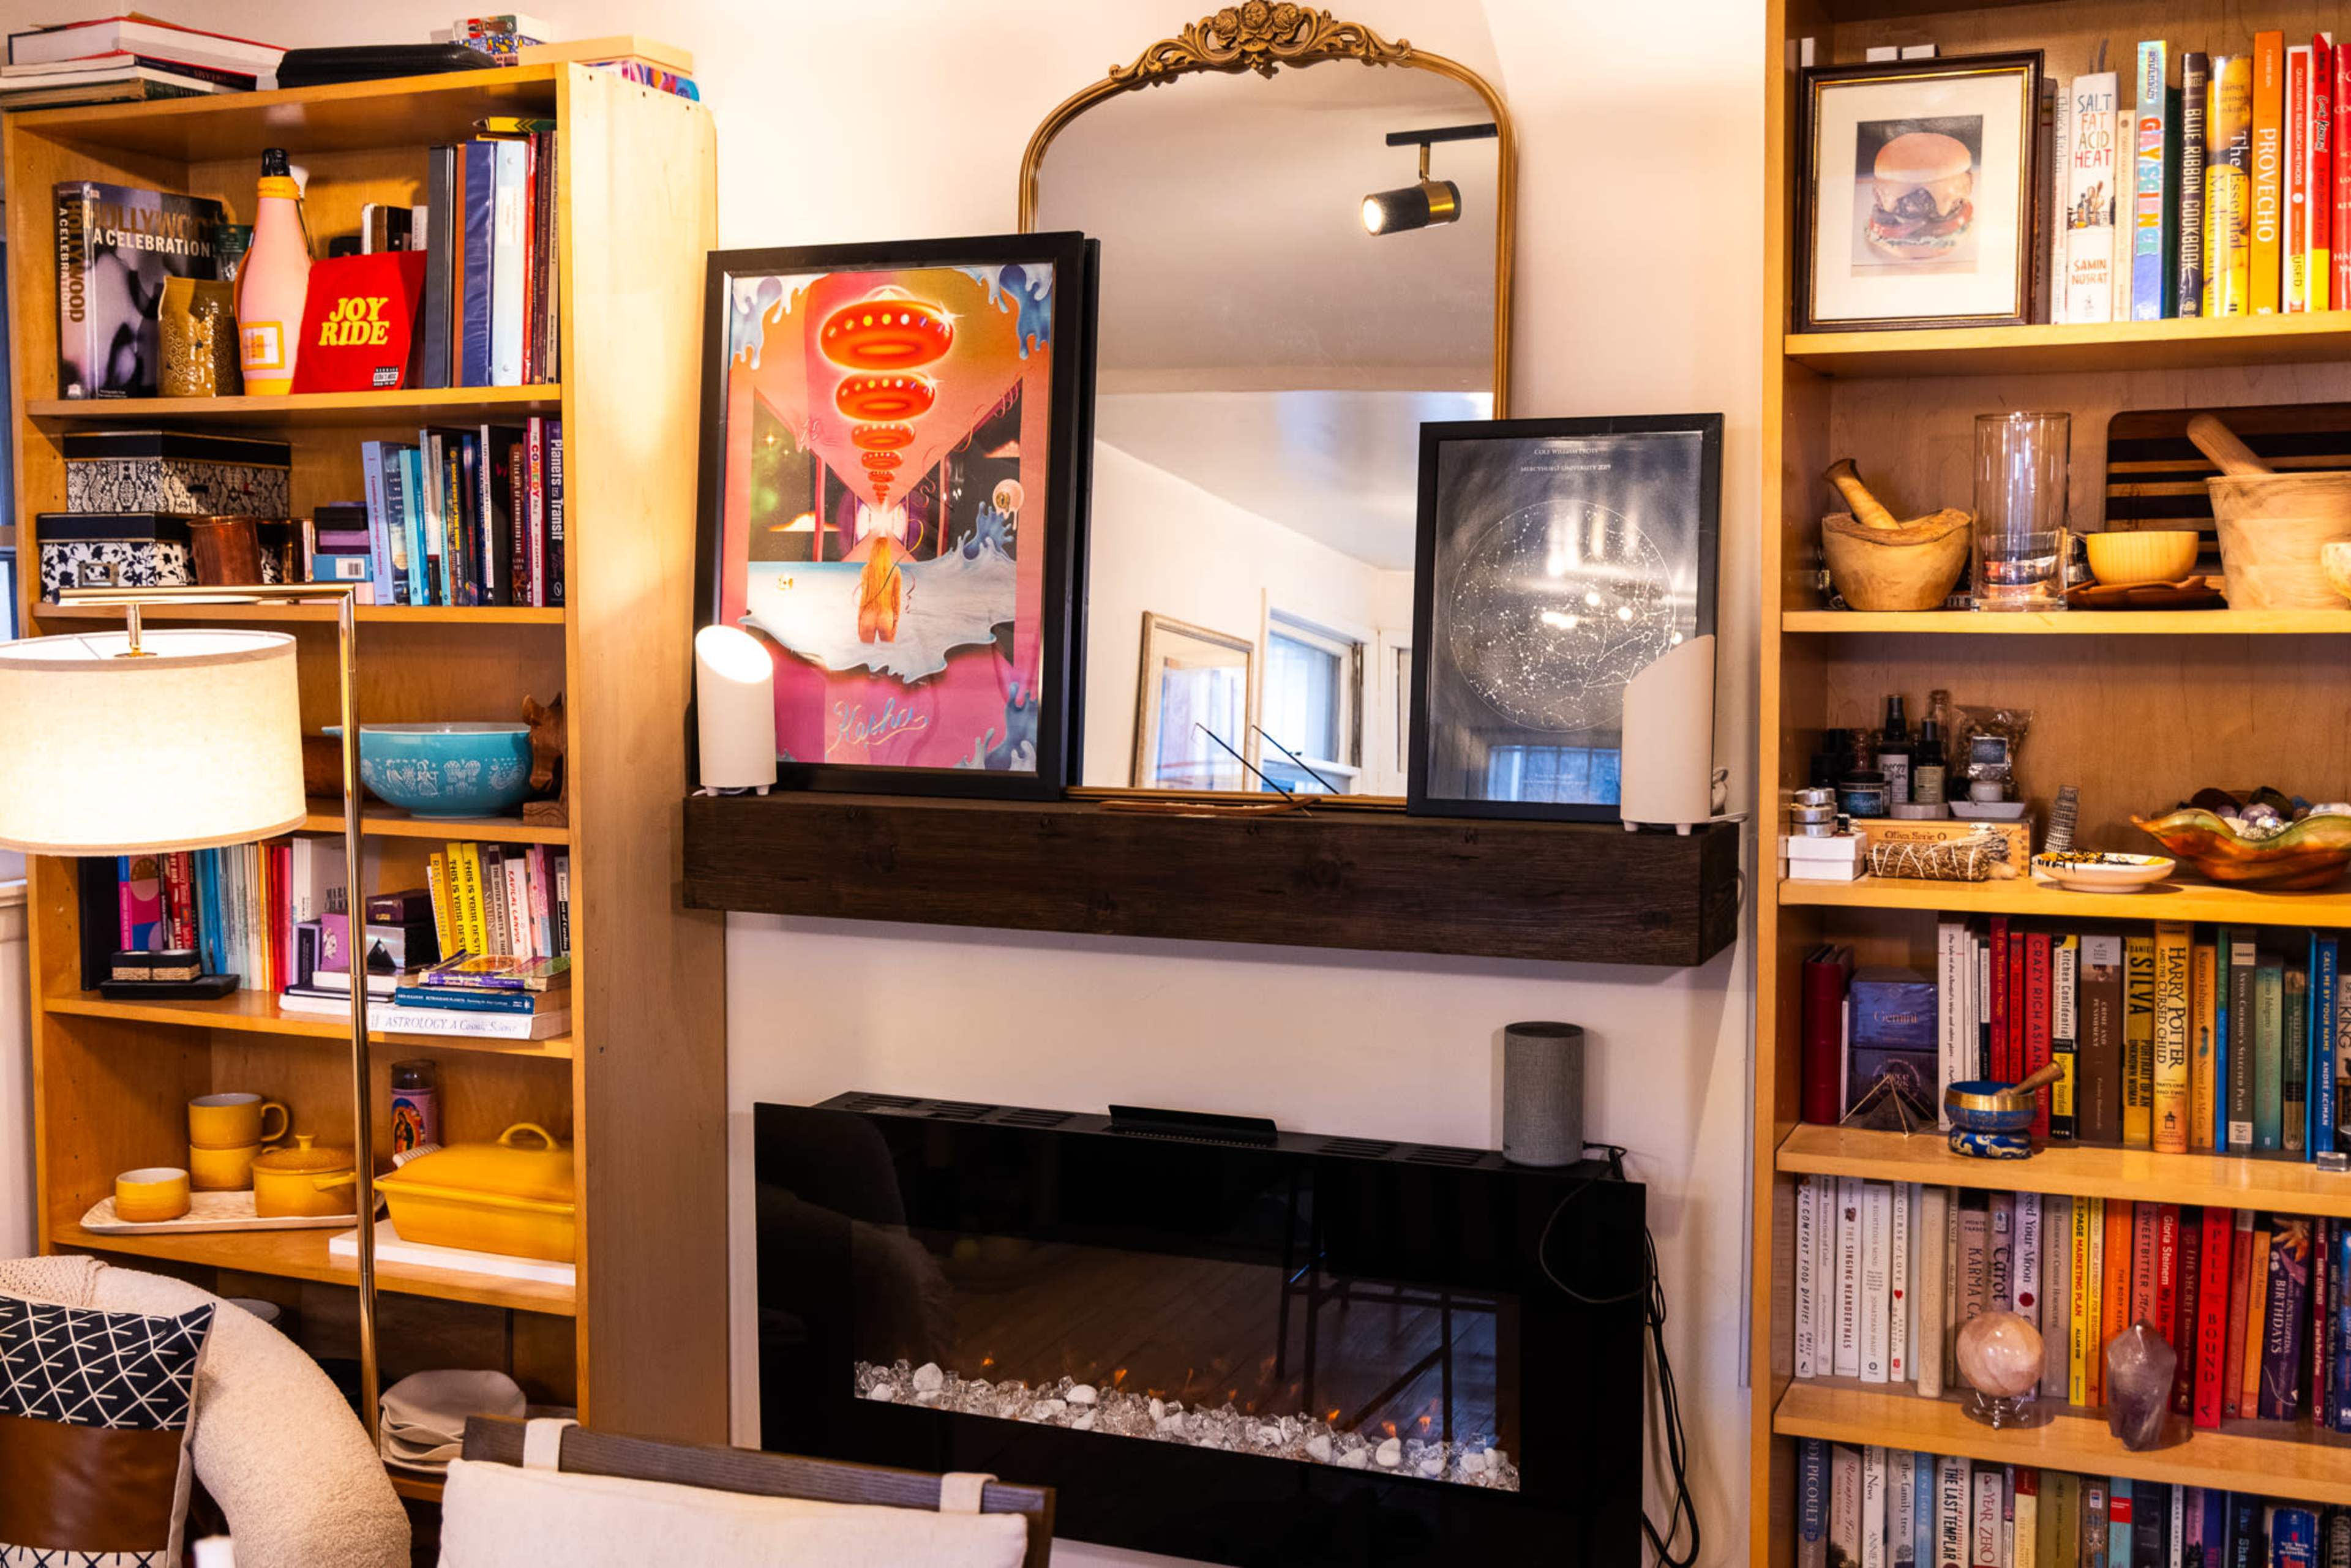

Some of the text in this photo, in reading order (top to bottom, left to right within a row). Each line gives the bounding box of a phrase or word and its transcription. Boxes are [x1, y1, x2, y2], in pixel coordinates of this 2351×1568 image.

[2077, 94, 2112, 113] SALT
[2082, 113, 2106, 130] FAT
[2054, 135, 2066, 173] Kitchen
[2075, 149, 2112, 168] HEAT
[2079, 131, 2109, 149] ACID
[2139, 118, 2161, 160] GAY
[2183, 108, 2201, 271] BLUE RIBBON COOKBOOK
[2257, 129, 2276, 242] PROVECHO
[93, 229, 103, 244] A
[2208, 130, 2249, 307] The Essential Mediterranean
[67, 201, 84, 322] HOLLYWOOD
[2072, 273, 2108, 285] NOSRAT
[2074, 260, 2107, 271] SAMIN
[2292, 256, 2302, 287] USED
[329, 298, 389, 322] JOY
[318, 321, 390, 347] RIDE
[550, 439, 563, 540] Planets Transit
[1884, 830, 1935, 841] Oliva Serie
[450, 860, 463, 921] THIS IS YOUR
[465, 860, 473, 882] THIS
[468, 885, 474, 893] IS
[440, 906, 448, 938] SHINE
[484, 891, 495, 930] SATURN
[2061, 950, 2072, 1038] Kitchen Confidential
[2129, 958, 2151, 1015] SILVA
[2156, 980, 2167, 1024] CURSED
[2196, 952, 2208, 1024] Kazuo Ishiguro
[2323, 975, 2330, 986] ME
[2323, 989, 2330, 999] BY
[386, 1016, 446, 1030] ASTROLOGY
[449, 1018, 458, 1030] A
[2033, 940, 2043, 1071] CRAZY RICH ASIANS
[2168, 947, 2186, 1069] HARRY POTTER
[2263, 997, 2273, 1027] Ishiguro
[2157, 1028, 2167, 1063] CHILD
[2128, 1040, 2138, 1106] UNKNOWN WOMAN
[2140, 1040, 2151, 1107] PORTRAIT OF AN
[2057, 1085, 2066, 1114] Bourdain
[1845, 1245, 1853, 1280] SINGING
[2023, 1220, 2035, 1283] Your Moon
[2140, 1210, 2152, 1287] SWEETBITTER
[2161, 1215, 2173, 1285] Gloria Steinem
[1967, 1248, 1982, 1296] KARMA
[1992, 1244, 2011, 1302] Tarot
[2184, 1250, 2195, 1315] THE SECRET
[1843, 1284, 1853, 1349] NEANDERTHALS
[2271, 1280, 2286, 1354] BIRTHDAYS
[1806, 1465, 1818, 1525] PICOULT
[1844, 1461, 1856, 1542] Redemption Falls
[1867, 1474, 1879, 1500] News
[1900, 1464, 1911, 1537] the family tree
[1943, 1468, 1958, 1560] THE LAST TEMPLAR
[1979, 1493, 1995, 1562] YEAR ZERO
[1869, 1531, 1878, 1561] ANNIE
